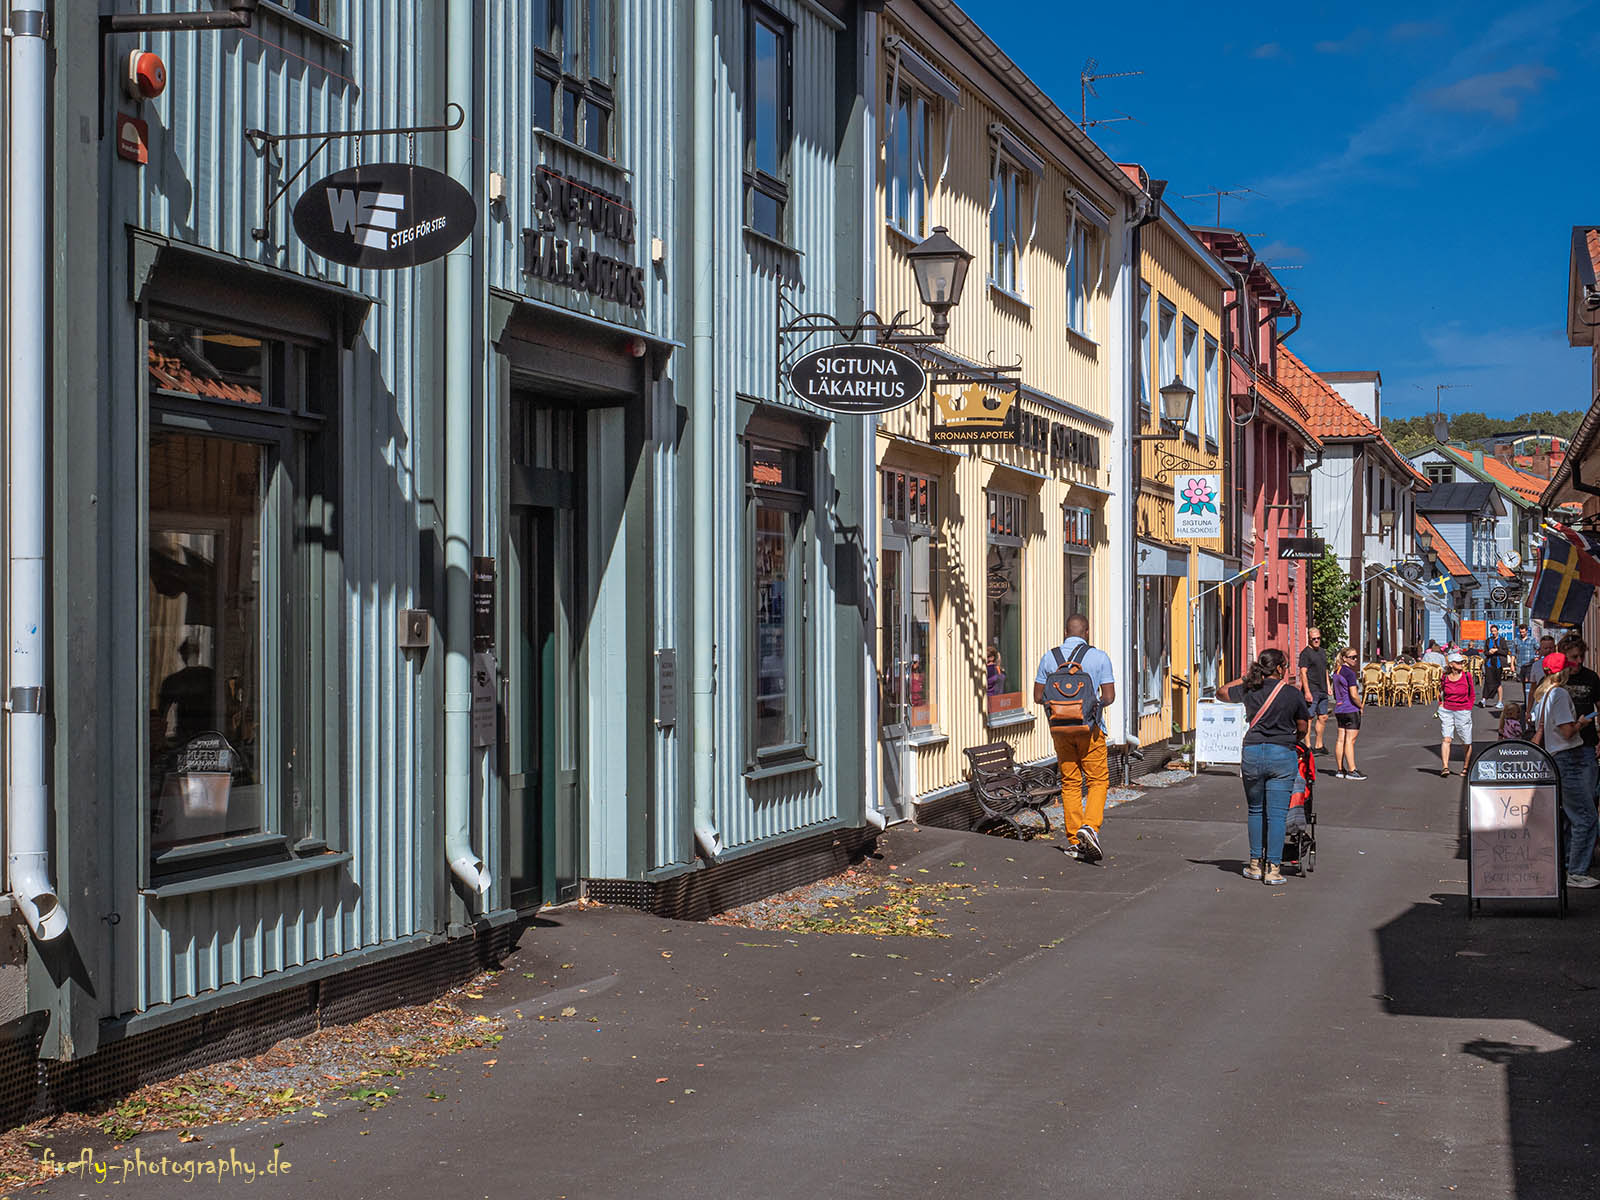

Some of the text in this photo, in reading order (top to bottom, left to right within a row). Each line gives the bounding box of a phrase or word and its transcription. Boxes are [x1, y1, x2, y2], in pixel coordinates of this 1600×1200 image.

[390, 216, 446, 249] STEG FÖR STEG
[816, 357, 898, 377] SIGTUNA
[808, 376, 905, 399] LÄKARHUS
[934, 430, 1015, 441] KRONANS APOTEK
